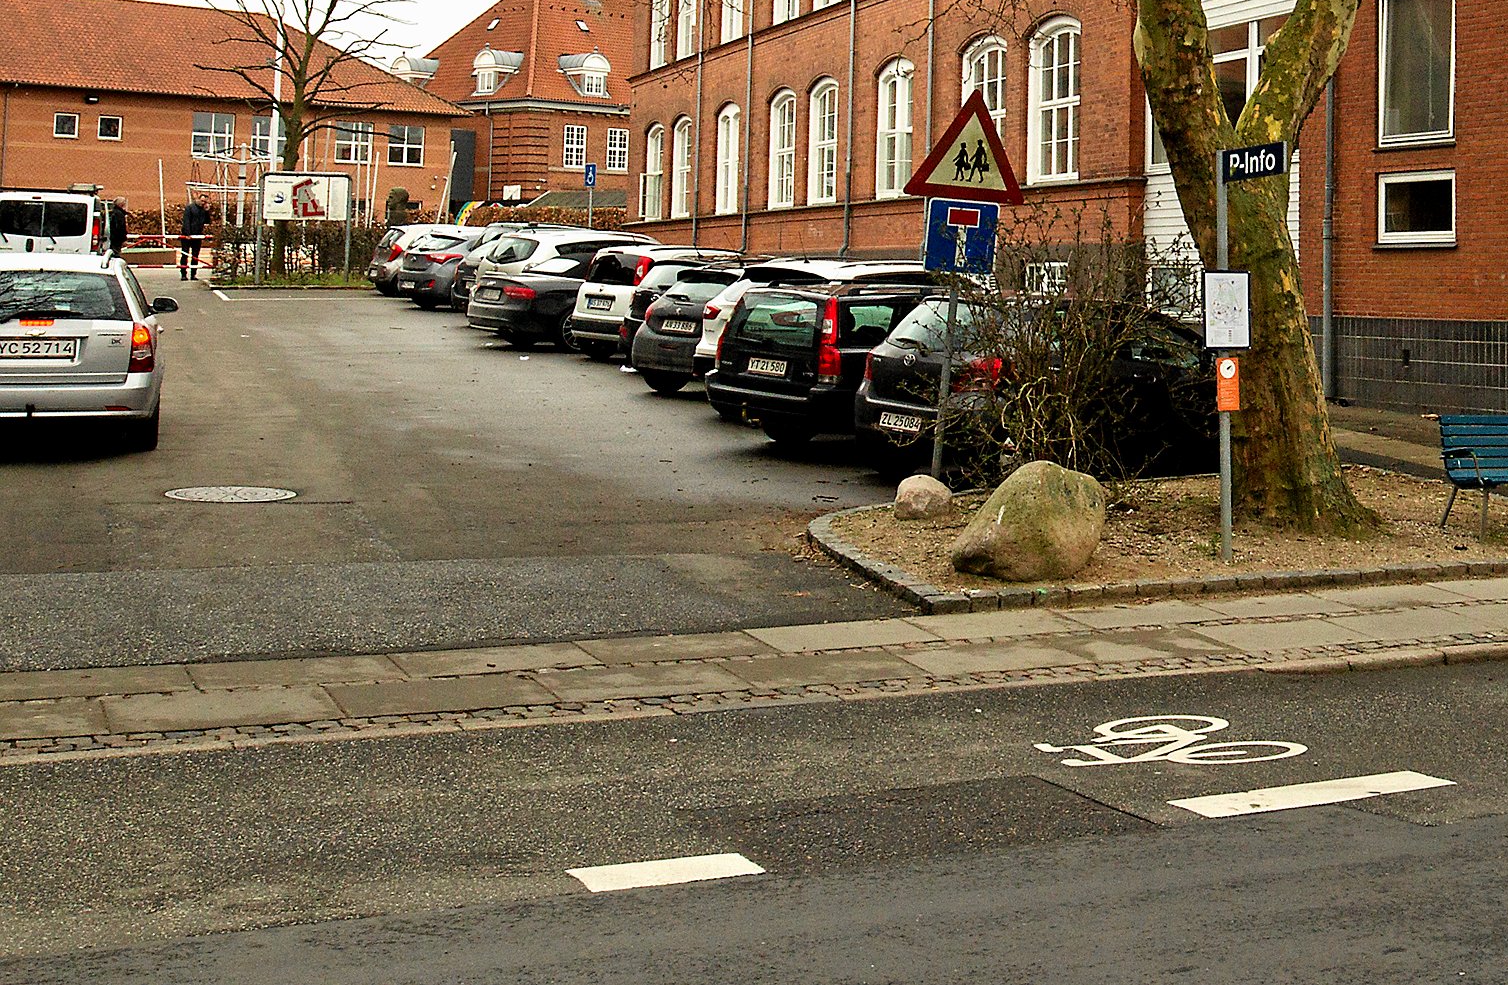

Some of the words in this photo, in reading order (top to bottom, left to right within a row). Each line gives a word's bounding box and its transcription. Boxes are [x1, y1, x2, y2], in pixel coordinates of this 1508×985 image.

[1229, 148, 1276, 177] P-Info
[22, 342, 41, 354] 52
[44, 342, 72, 354] 714
[750, 358, 760, 370] YT
[881, 413, 892, 425] ZL
